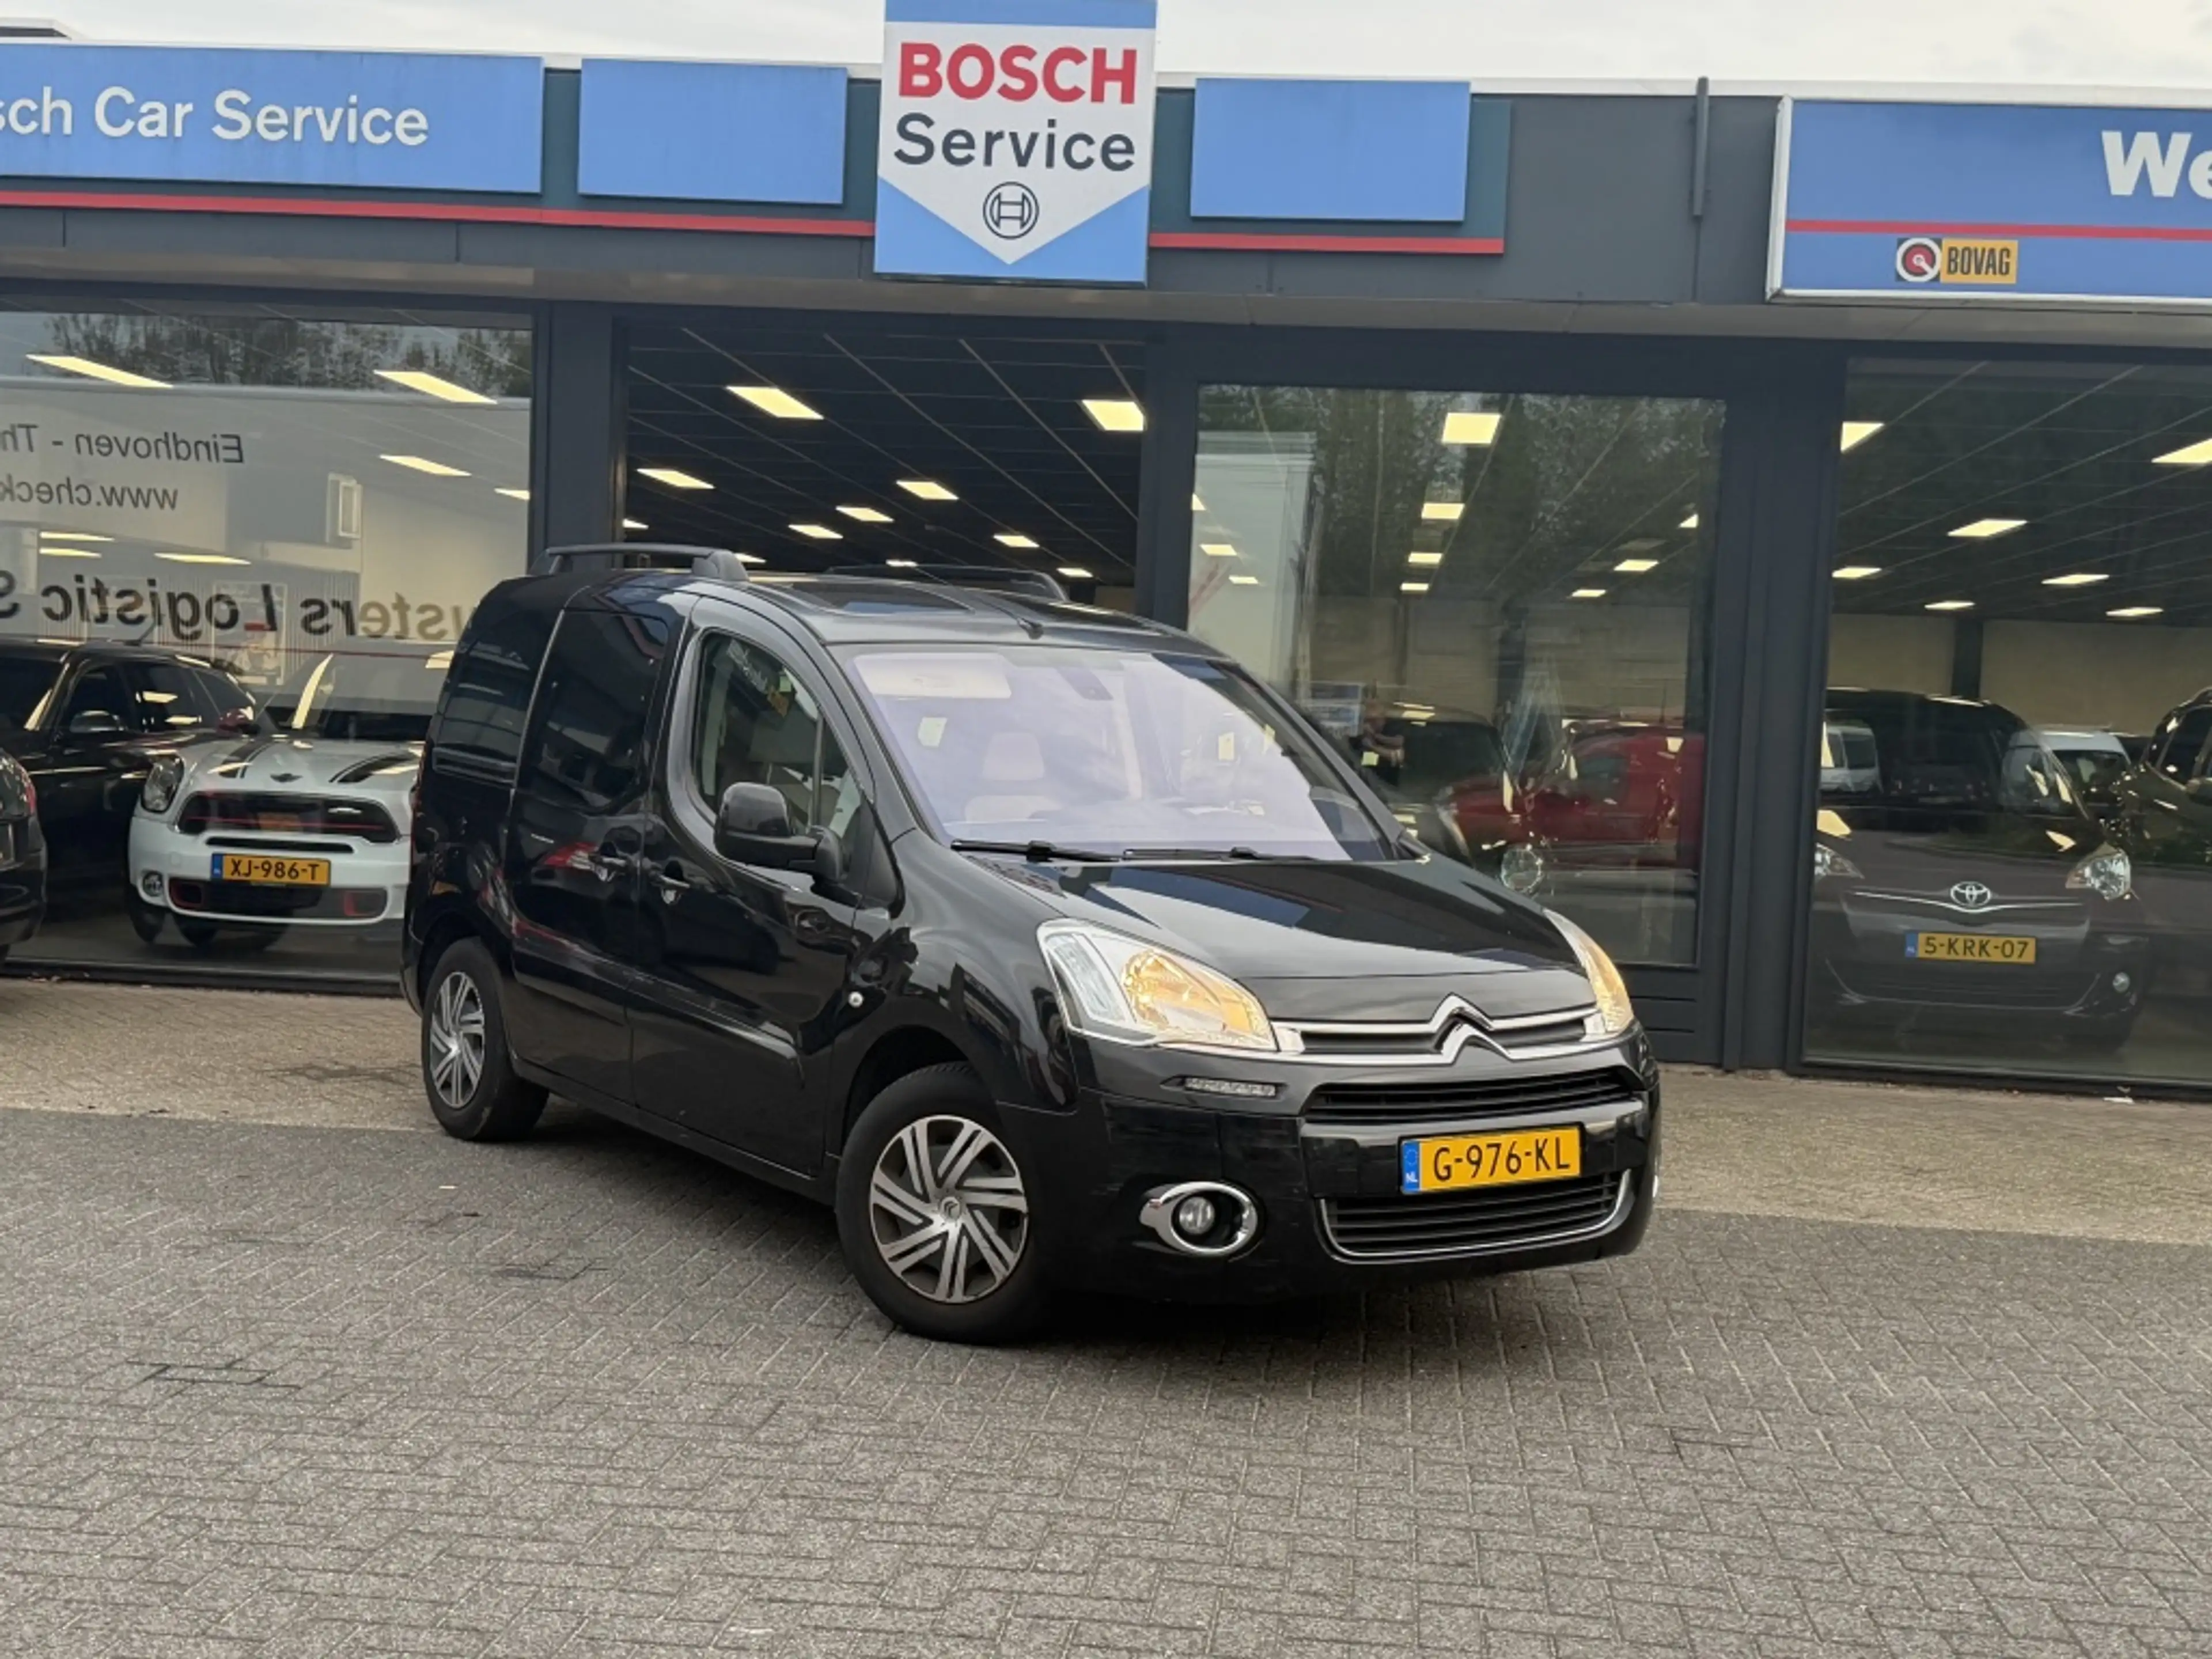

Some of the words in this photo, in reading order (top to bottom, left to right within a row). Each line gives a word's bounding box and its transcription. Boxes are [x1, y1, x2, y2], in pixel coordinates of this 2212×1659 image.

[899, 42, 1137, 104] BOSCH
[0, 86, 73, 135] ch
[95, 86, 193, 139] Car
[211, 89, 429, 146] Service
[894, 112, 1135, 172] Service
[1946, 246, 2010, 276] BOVAG
[230, 858, 320, 881] XJ-986-T
[1925, 936, 2029, 959] 5-KRK-07
[1433, 1137, 1571, 1181] G-976-KL
